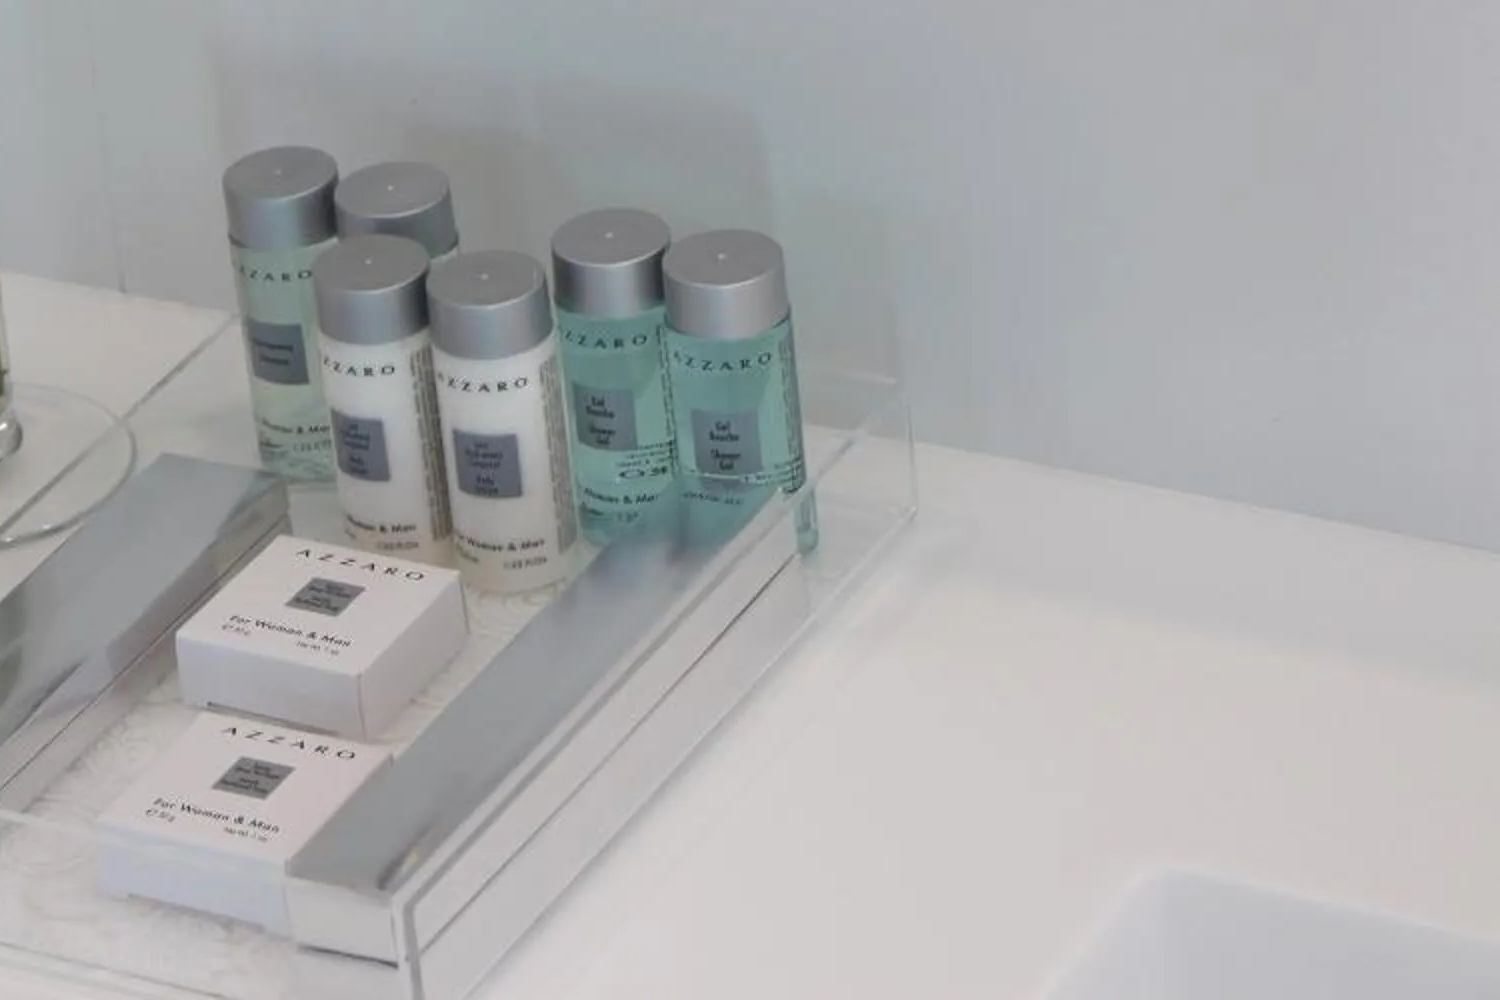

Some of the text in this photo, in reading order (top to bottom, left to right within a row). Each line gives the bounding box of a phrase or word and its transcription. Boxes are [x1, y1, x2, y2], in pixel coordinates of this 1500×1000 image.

[296, 548, 425, 581] AZZARO
[228, 614, 252, 625] For
[255, 618, 303, 637] Woman
[306, 630, 318, 641] &
[321, 634, 352, 648] Man
[220, 726, 356, 760] AZZARO
[151, 796, 177, 810] For
[180, 803, 229, 822] Woman
[233, 814, 245, 826] &
[248, 817, 281, 833] Man
